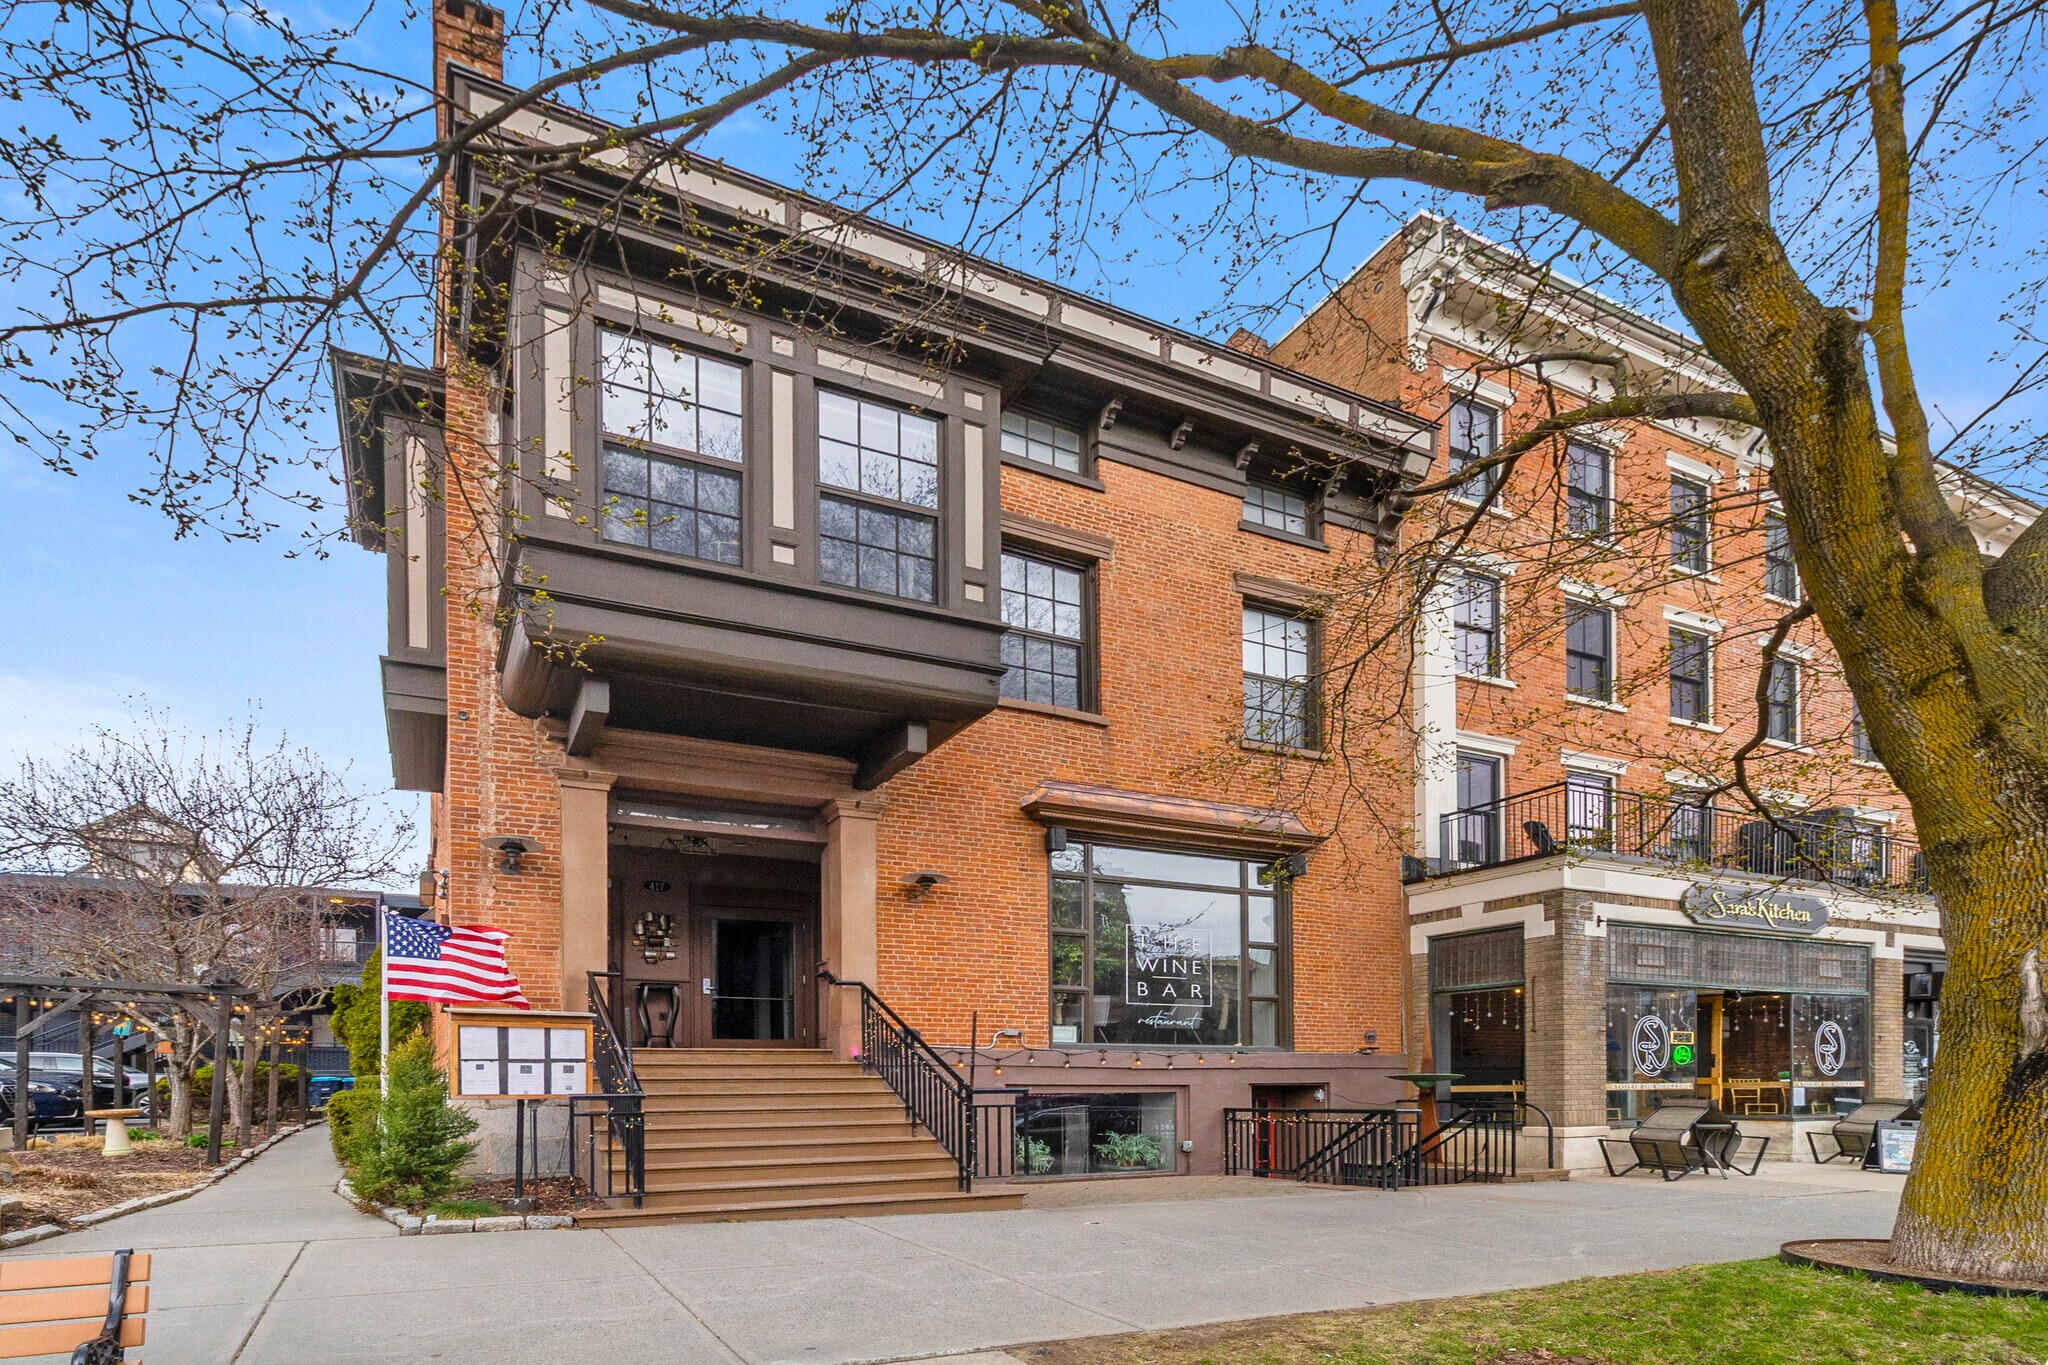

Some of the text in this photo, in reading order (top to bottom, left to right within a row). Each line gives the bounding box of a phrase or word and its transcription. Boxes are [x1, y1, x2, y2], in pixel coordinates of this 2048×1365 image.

[649, 882, 665, 891] 417
[1707, 891, 1813, 928] Sara's Kitchen
[1136, 934, 1202, 952] THE
[1136, 957, 1202, 975] WINE
[1137, 981, 1203, 999] BAR
[1137, 1009, 1204, 1030] restaurant
